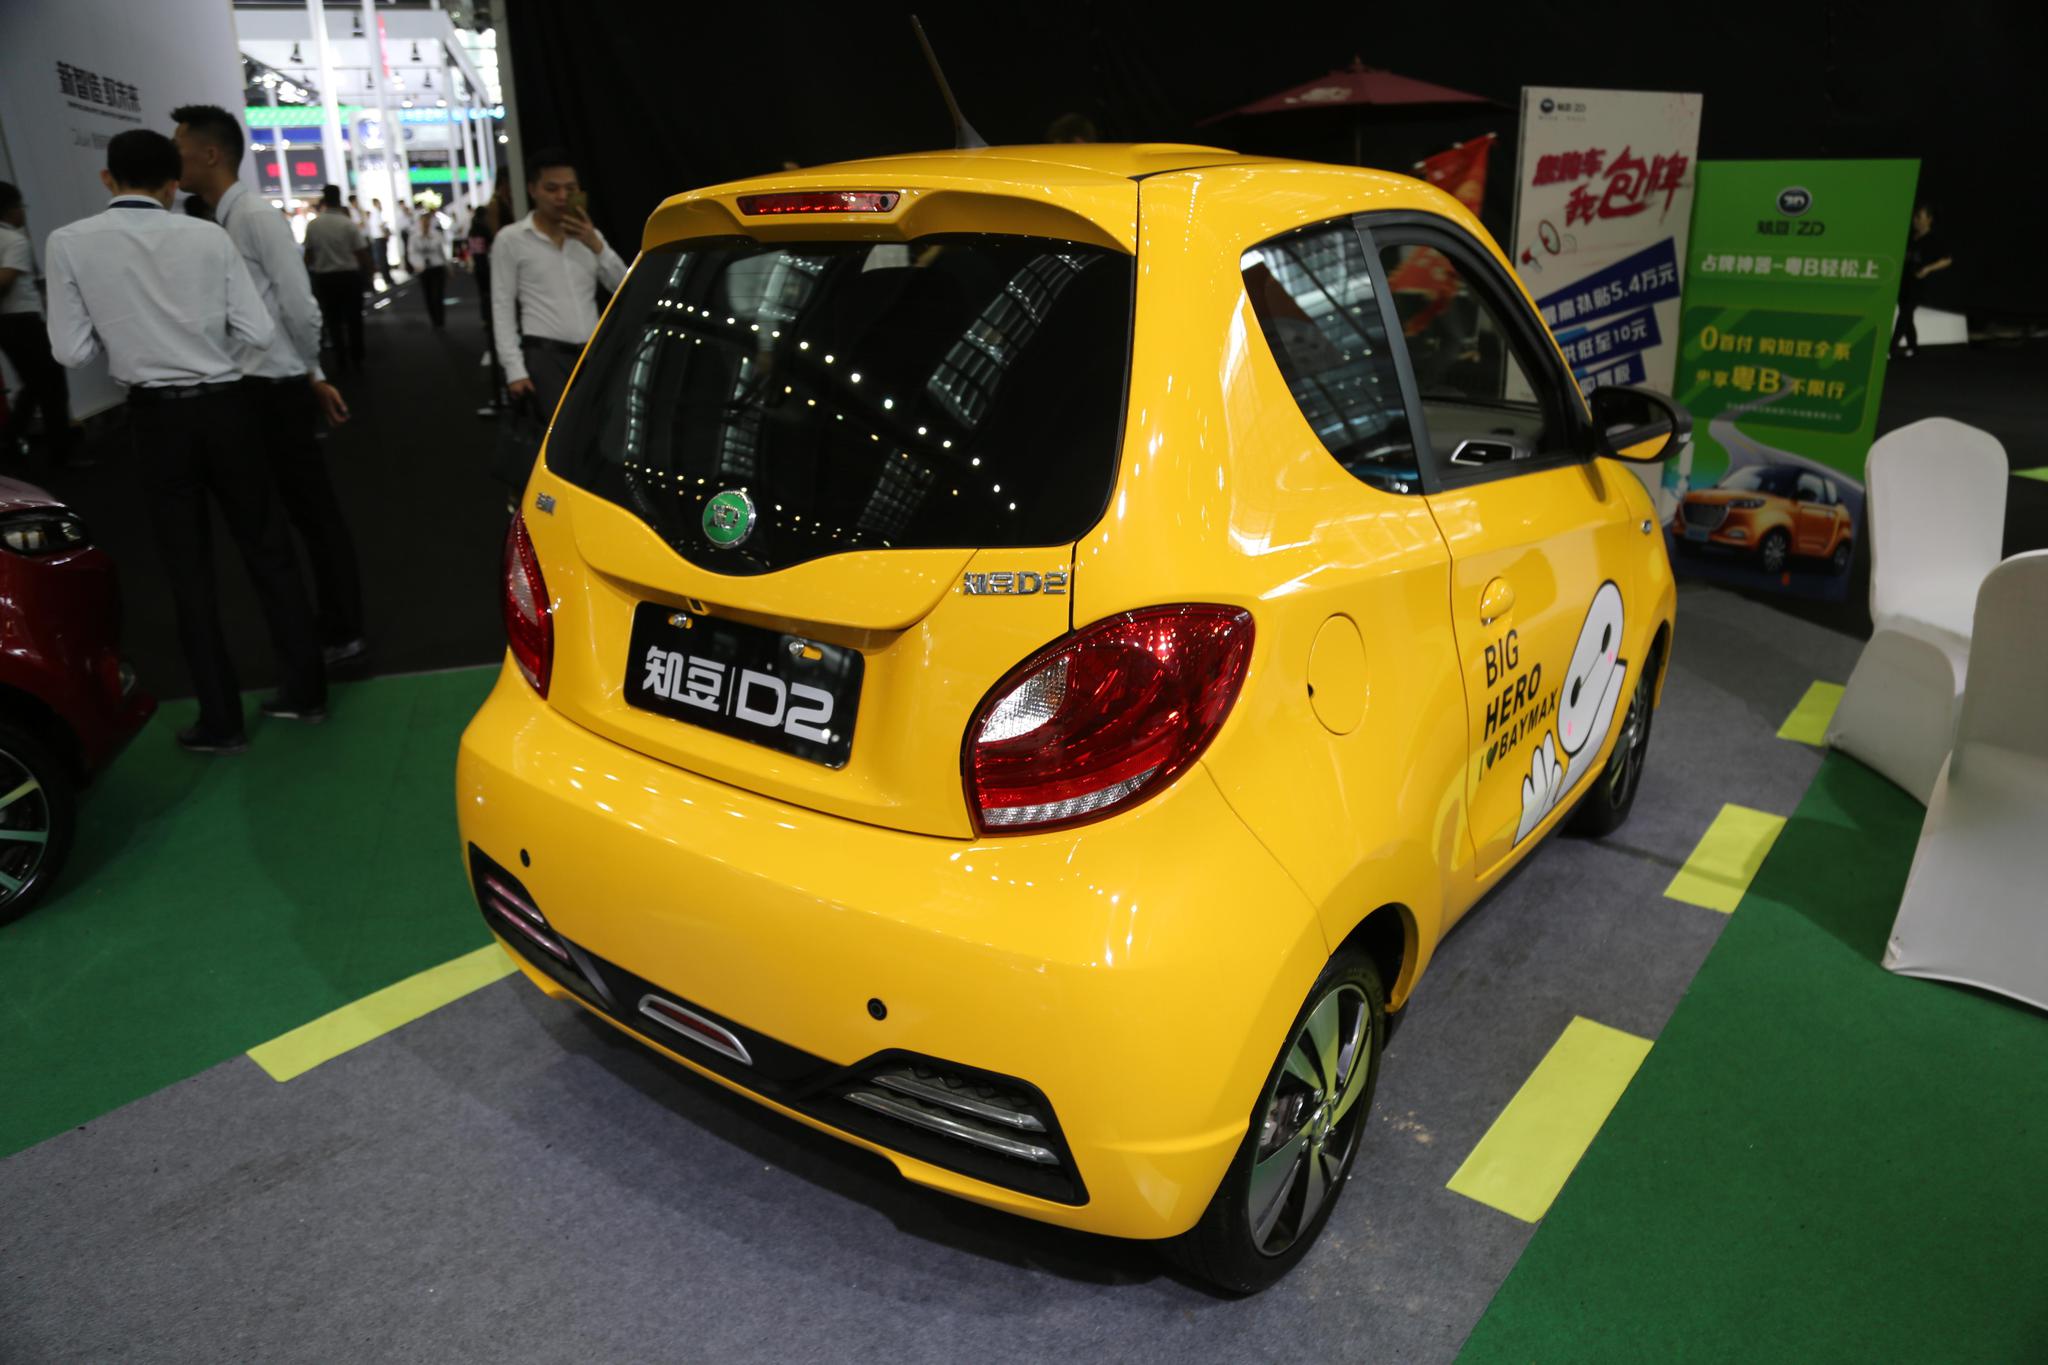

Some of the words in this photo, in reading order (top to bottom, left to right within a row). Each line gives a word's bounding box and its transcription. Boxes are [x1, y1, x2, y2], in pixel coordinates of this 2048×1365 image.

[1565, 145, 1689, 227] 我包牌
[642, 645, 726, 712] 知豆
[735, 668, 834, 745] D2
[1484, 629, 1519, 689] BIG
[1484, 663, 1542, 742] HERO
[1498, 688, 1558, 761] BAYMAX
